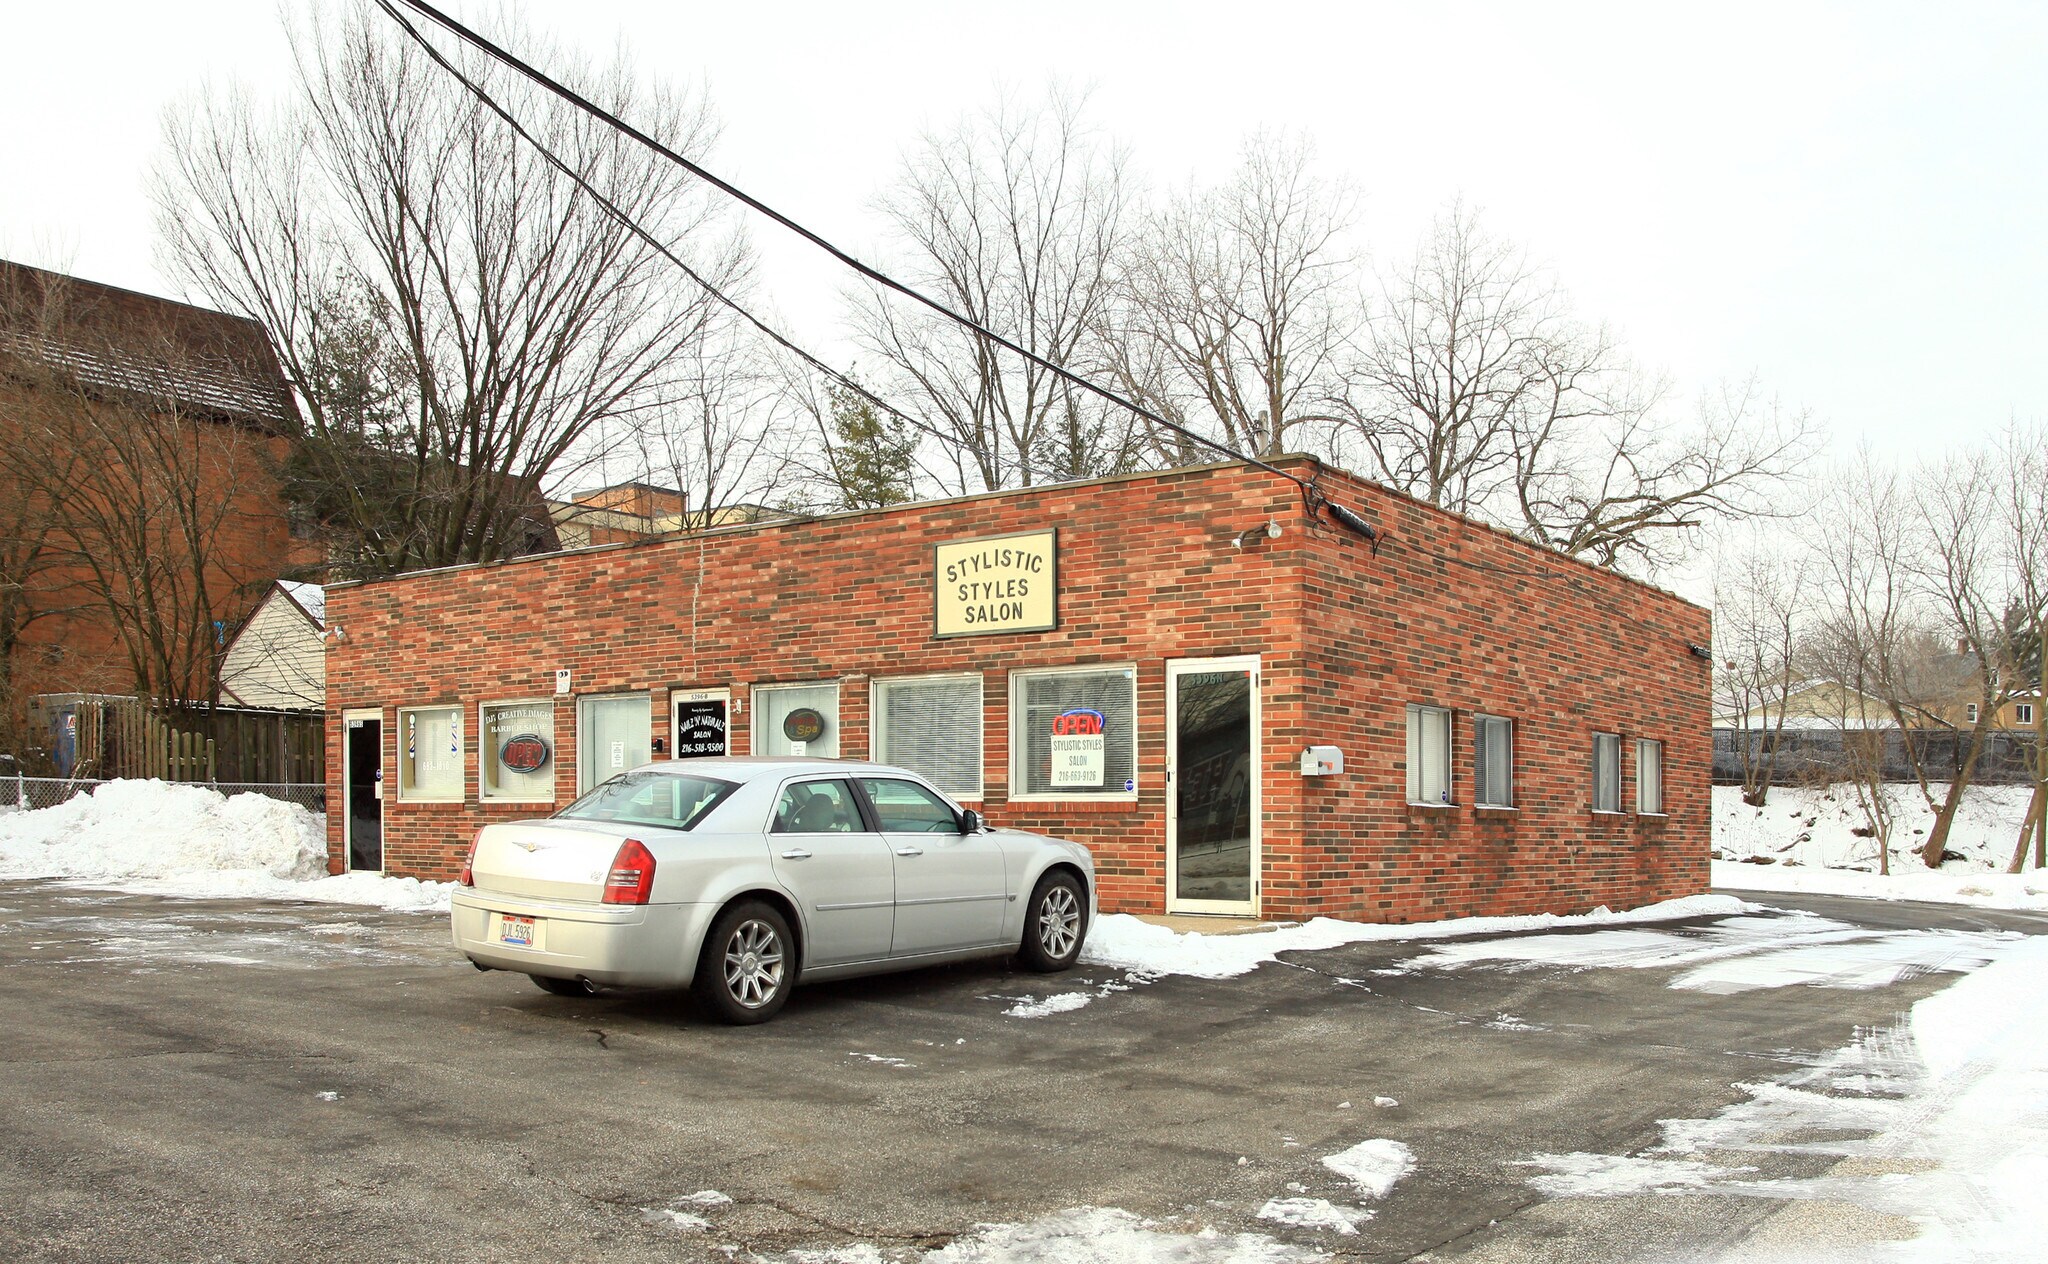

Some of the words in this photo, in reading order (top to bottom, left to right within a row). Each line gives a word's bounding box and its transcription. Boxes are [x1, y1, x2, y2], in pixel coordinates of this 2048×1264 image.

[947, 549, 1042, 582] STYLISTIC
[957, 578, 1029, 602] STYLES
[964, 601, 1023, 624] SALON
[497, 710, 528, 721] CREATIVE
[491, 725, 522, 733] BARBER
[1053, 715, 1101, 735] OPEN
[693, 730, 712, 739] SALON
[681, 742, 725, 753] 216-518-9500
[1053, 739, 1082, 752] STYLISTIC
[1082, 739, 1103, 751] STYLES
[505, 742, 542, 767] OPEN
[1068, 755, 1088, 767] SALON
[1058, 770, 1097, 782] 216-663-9126
